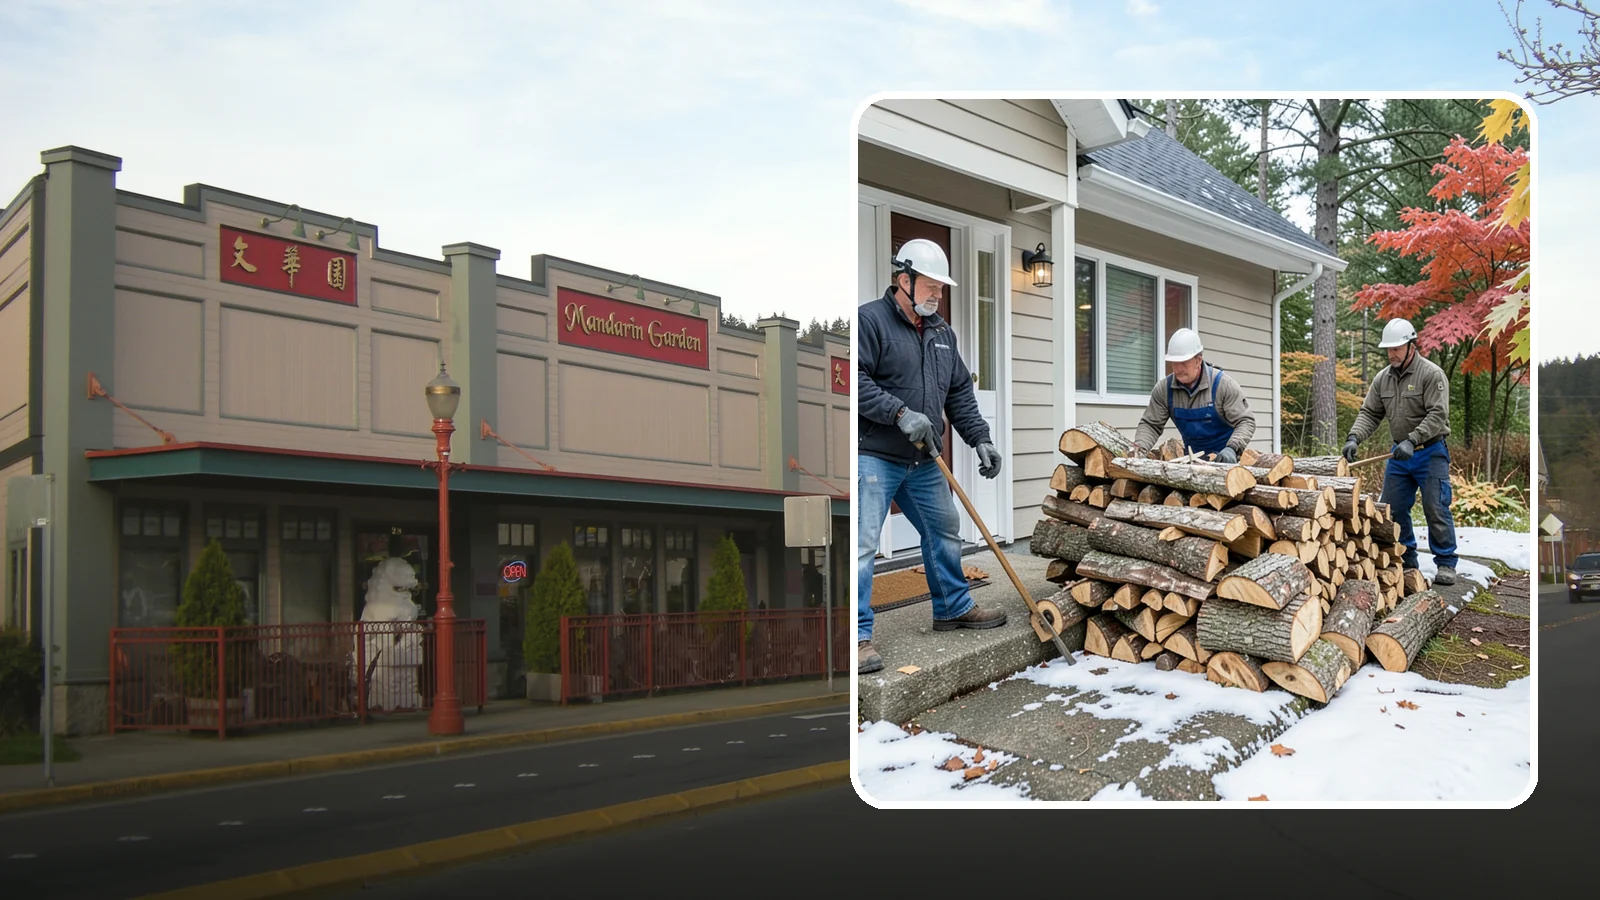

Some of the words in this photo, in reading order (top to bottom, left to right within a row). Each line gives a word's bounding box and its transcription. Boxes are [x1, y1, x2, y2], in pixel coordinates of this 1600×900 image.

[564, 302, 643, 341] Mandarin
[647, 320, 701, 352] Garden
[503, 565, 527, 578] OPEN
